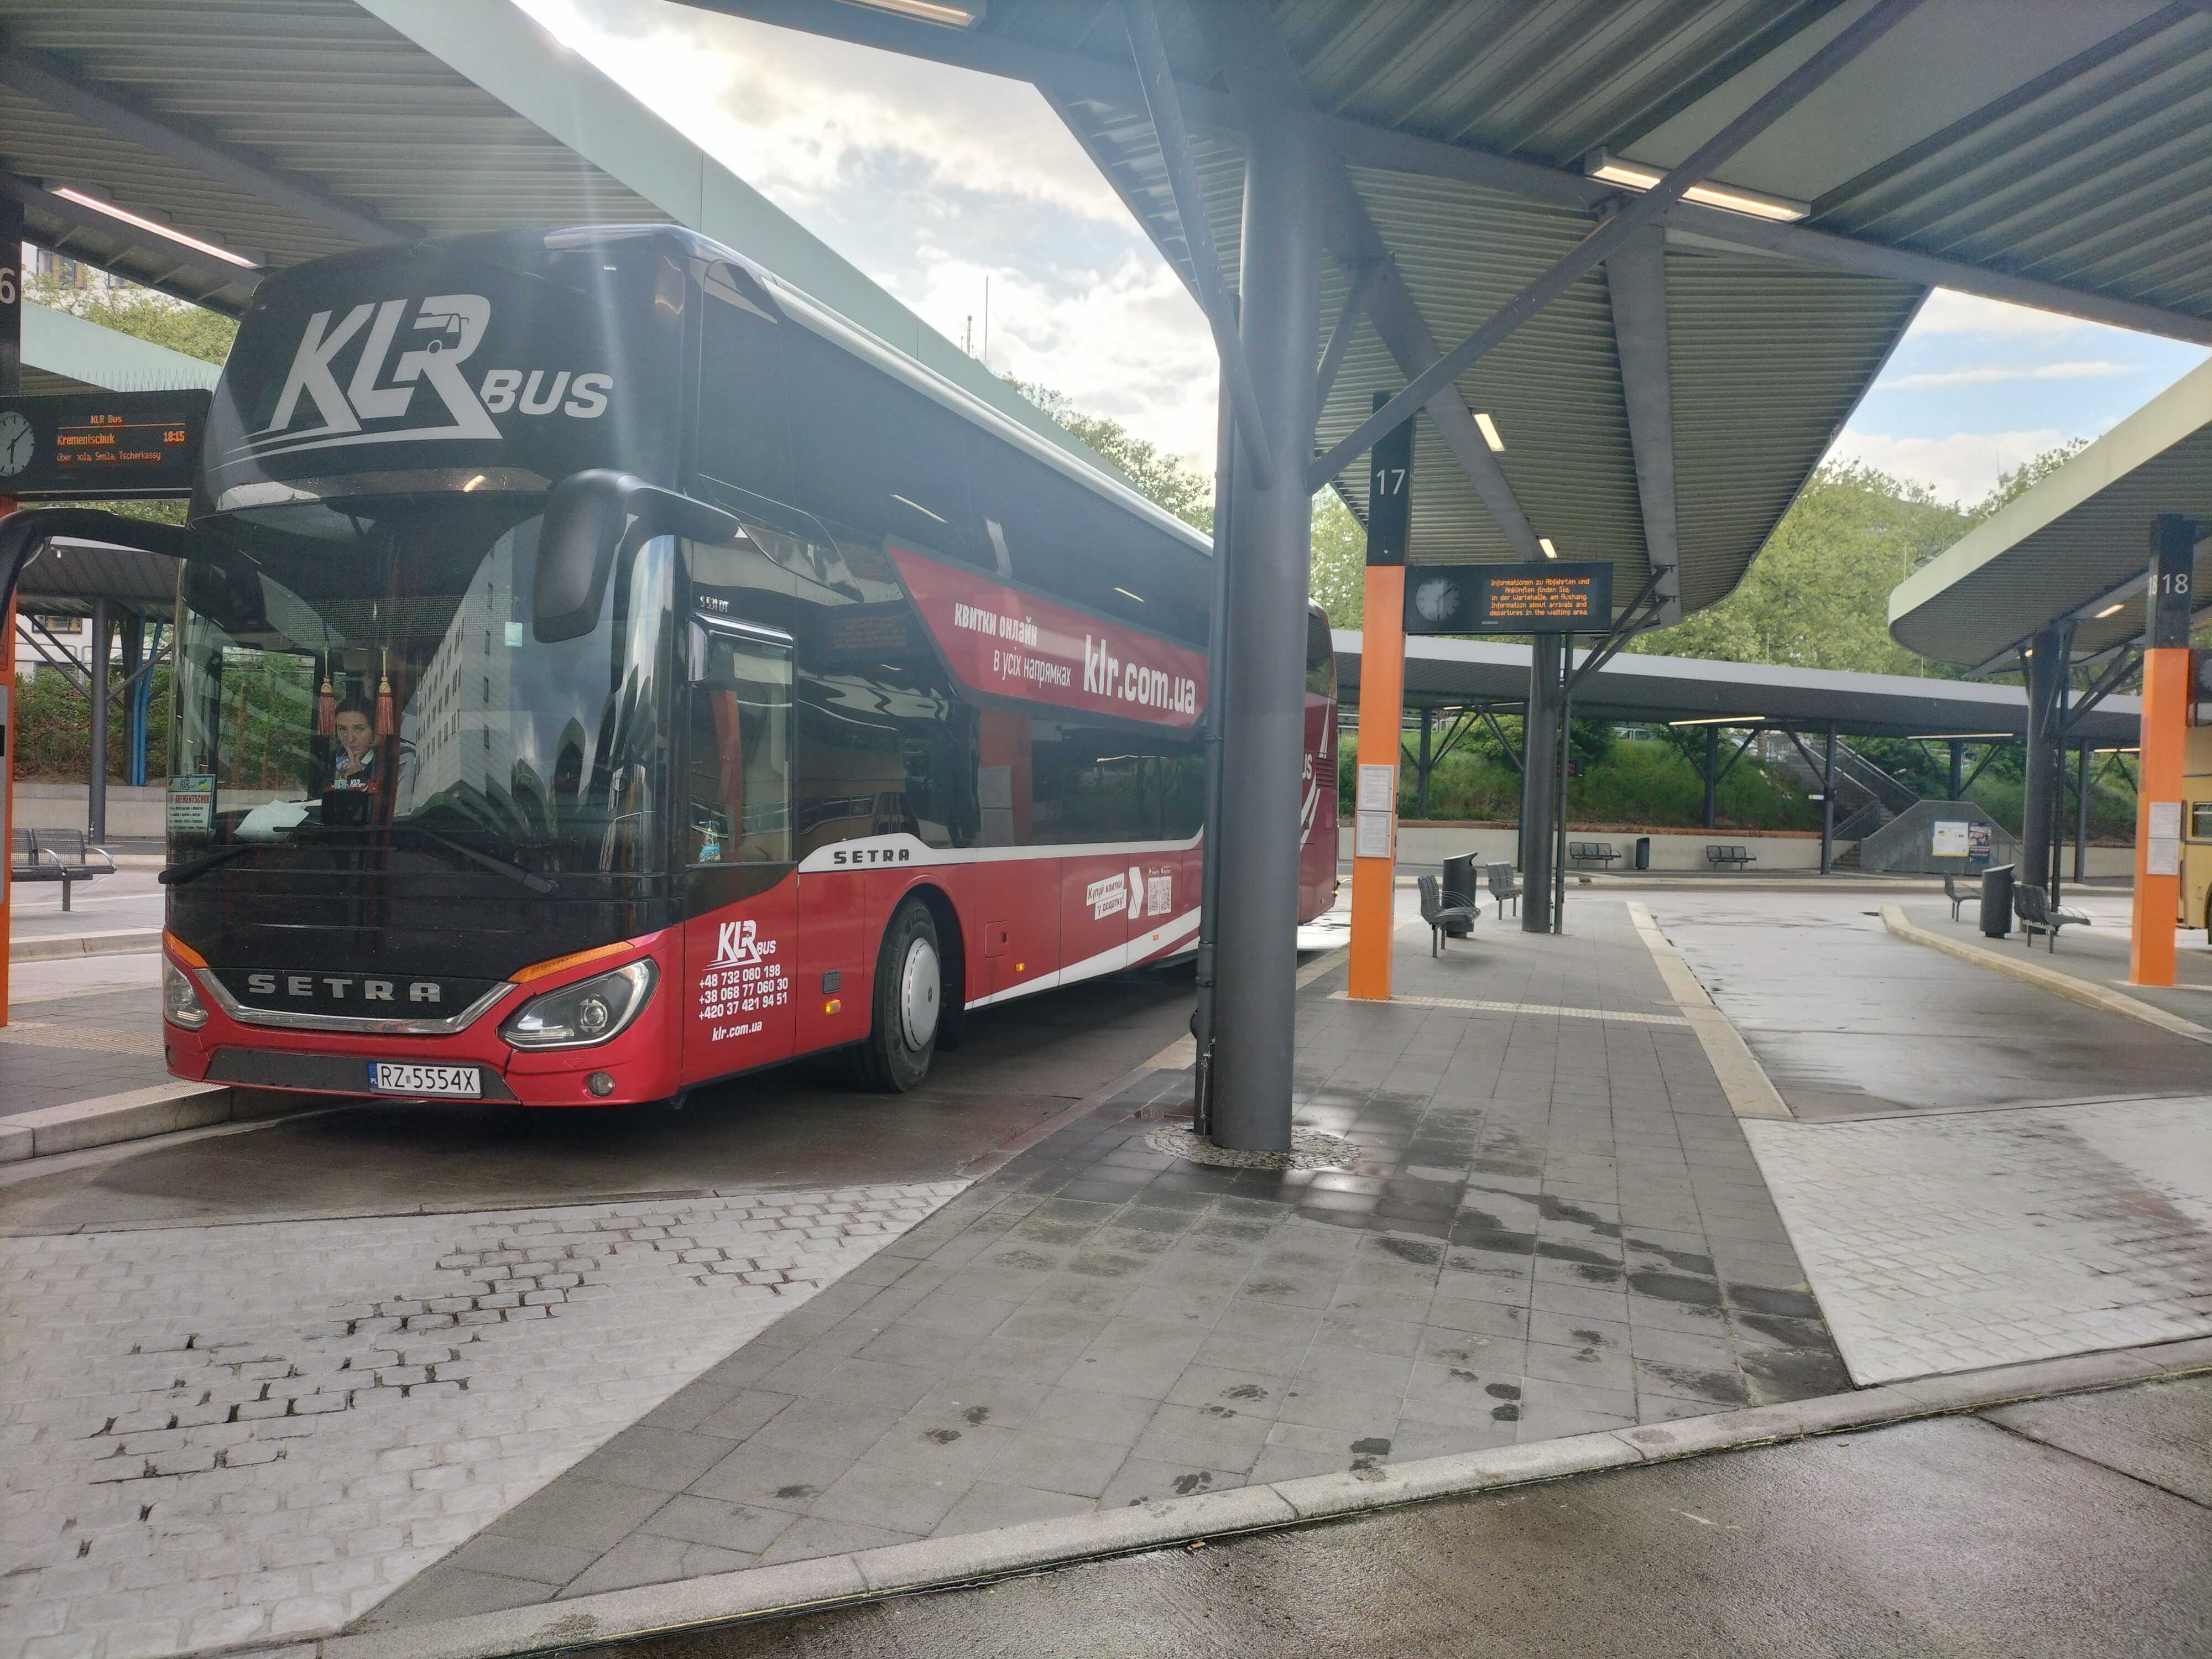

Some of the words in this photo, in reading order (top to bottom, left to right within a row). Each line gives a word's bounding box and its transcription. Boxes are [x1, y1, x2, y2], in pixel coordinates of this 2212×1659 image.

[0, 268, 15, 305] 6
[260, 294, 503, 439] KLR
[480, 369, 613, 418] BUS
[91, 415, 105, 424] KLR
[108, 415, 122, 423] Bus
[57, 434, 115, 445] Krementschuk
[163, 430, 186, 442] 18:15
[57, 452, 71, 462] über
[95, 451, 116, 461] Smila,
[119, 451, 161, 461] Tscherkassy
[1376, 469, 1406, 495] 17
[1490, 579, 1533, 587] Informationen
[1546, 578, 1576, 587] Abfahrten
[1537, 587, 1557, 595] finden
[2148, 575, 2158, 597] 18
[2163, 573, 2188, 594] 18
[700, 595, 705, 607] S
[718, 599, 729, 613] DT
[954, 603, 997, 635] квитки
[999, 615, 1037, 646] онлайн
[993, 649, 1000, 672] в
[1003, 647, 1021, 680] усіх
[1024, 660, 1071, 689] напрямках
[1083, 634, 1196, 714] klr.com.ua
[834, 848, 910, 864] SETRA
[1088, 884, 1104, 901] Купуй
[1105, 880, 1122, 891] квитки
[1098, 905, 1101, 916] у
[713, 920, 762, 963] KLR
[757, 940, 776, 955] BUS
[699, 974, 718, 988] +48
[721, 970, 740, 985] 732
[743, 967, 760, 982] 080
[764, 964, 780, 978] 198
[248, 974, 441, 1003] SETRA
[699, 989, 718, 1005] +38
[721, 985, 740, 1001] 068
[743, 983, 754, 997] 77
[757, 980, 774, 994] 060
[776, 977, 788, 991] 30
[699, 1004, 723, 1020] +420
[727, 1001, 739, 1016] 37
[742, 997, 759, 1012] 421
[762, 995, 774, 1009] 94
[776, 992, 787, 1005] 51
[712, 1021, 763, 1041] klr.com.ua
[381, 1066, 405, 1088] RZ
[413, 1068, 474, 1091] 5554X
